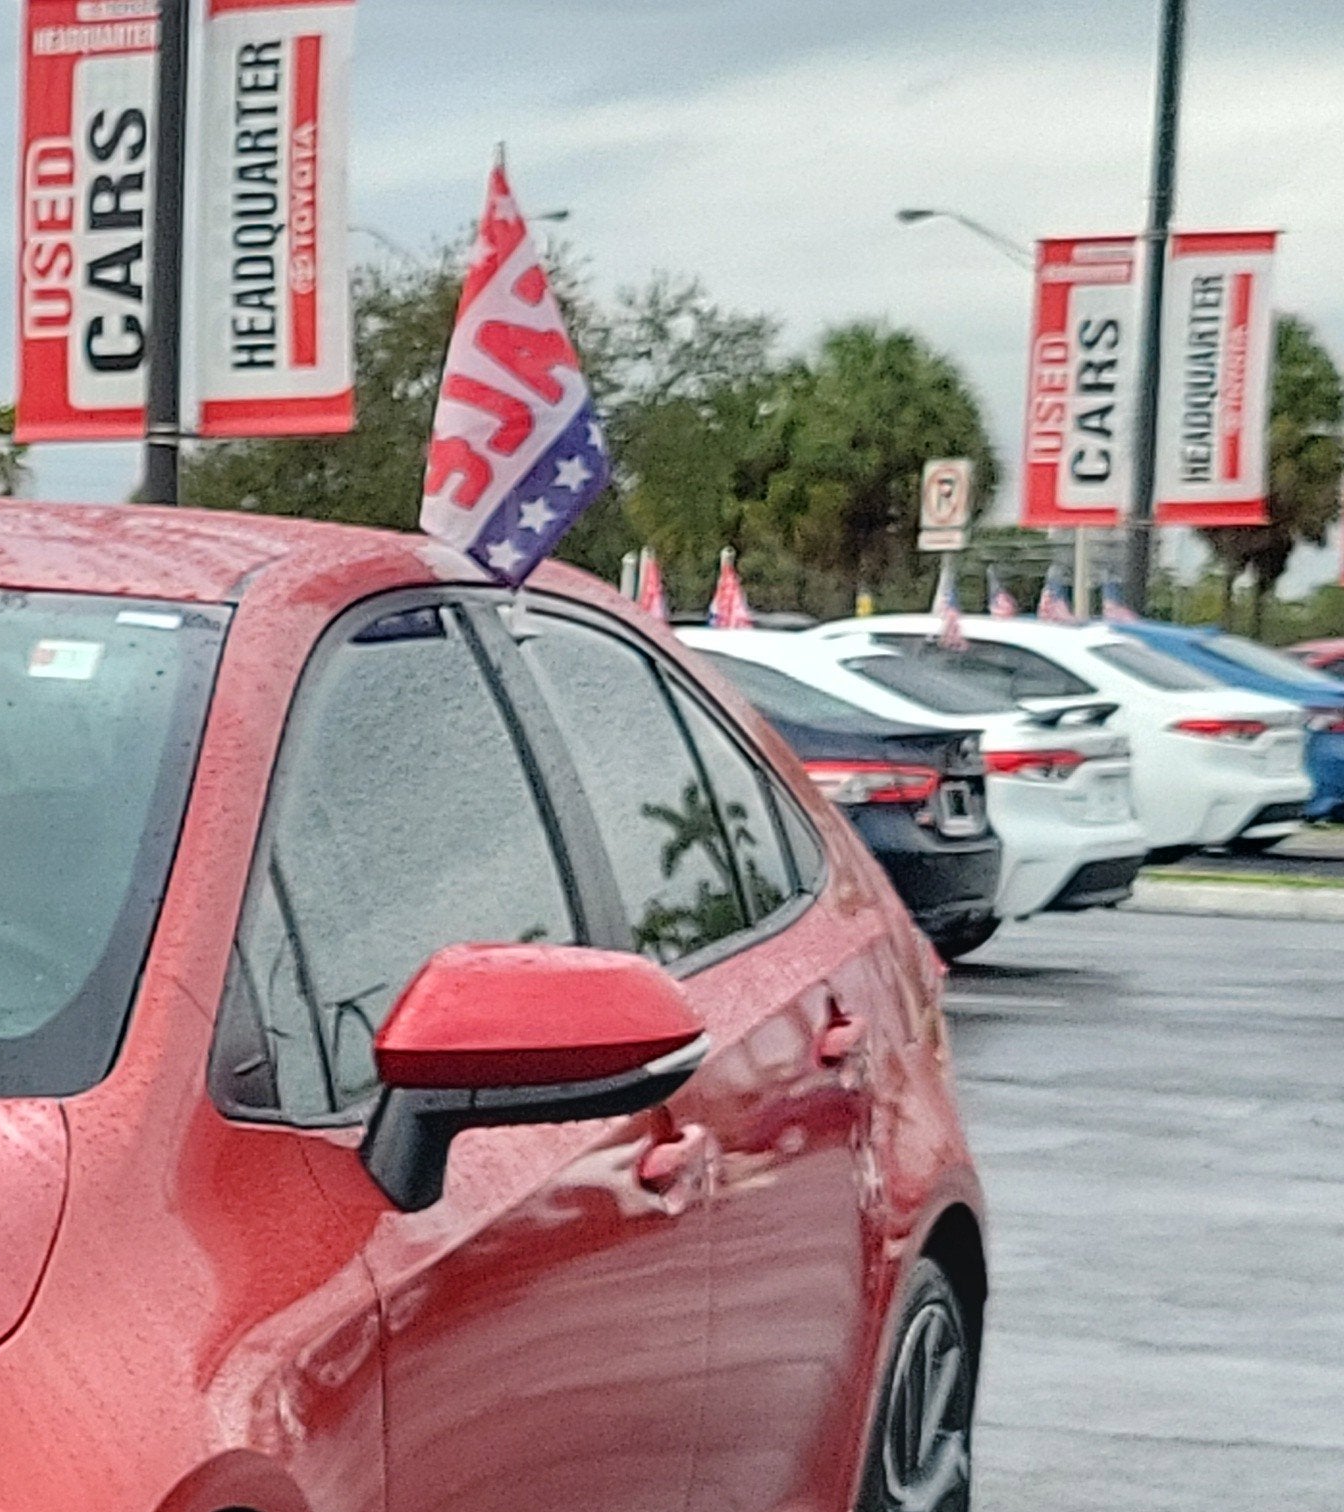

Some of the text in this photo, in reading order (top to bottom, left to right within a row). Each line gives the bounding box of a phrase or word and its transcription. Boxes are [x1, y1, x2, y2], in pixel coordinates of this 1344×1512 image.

[29, 144, 74, 329] USED
[86, 107, 147, 374] CARS
[232, 39, 285, 371] HEADQUARTER
[291, 125, 316, 251] TOYOTA
[1029, 338, 1068, 460] USED
[1072, 317, 1120, 483] CARS
[1180, 275, 1224, 483] HEADQUARTER
